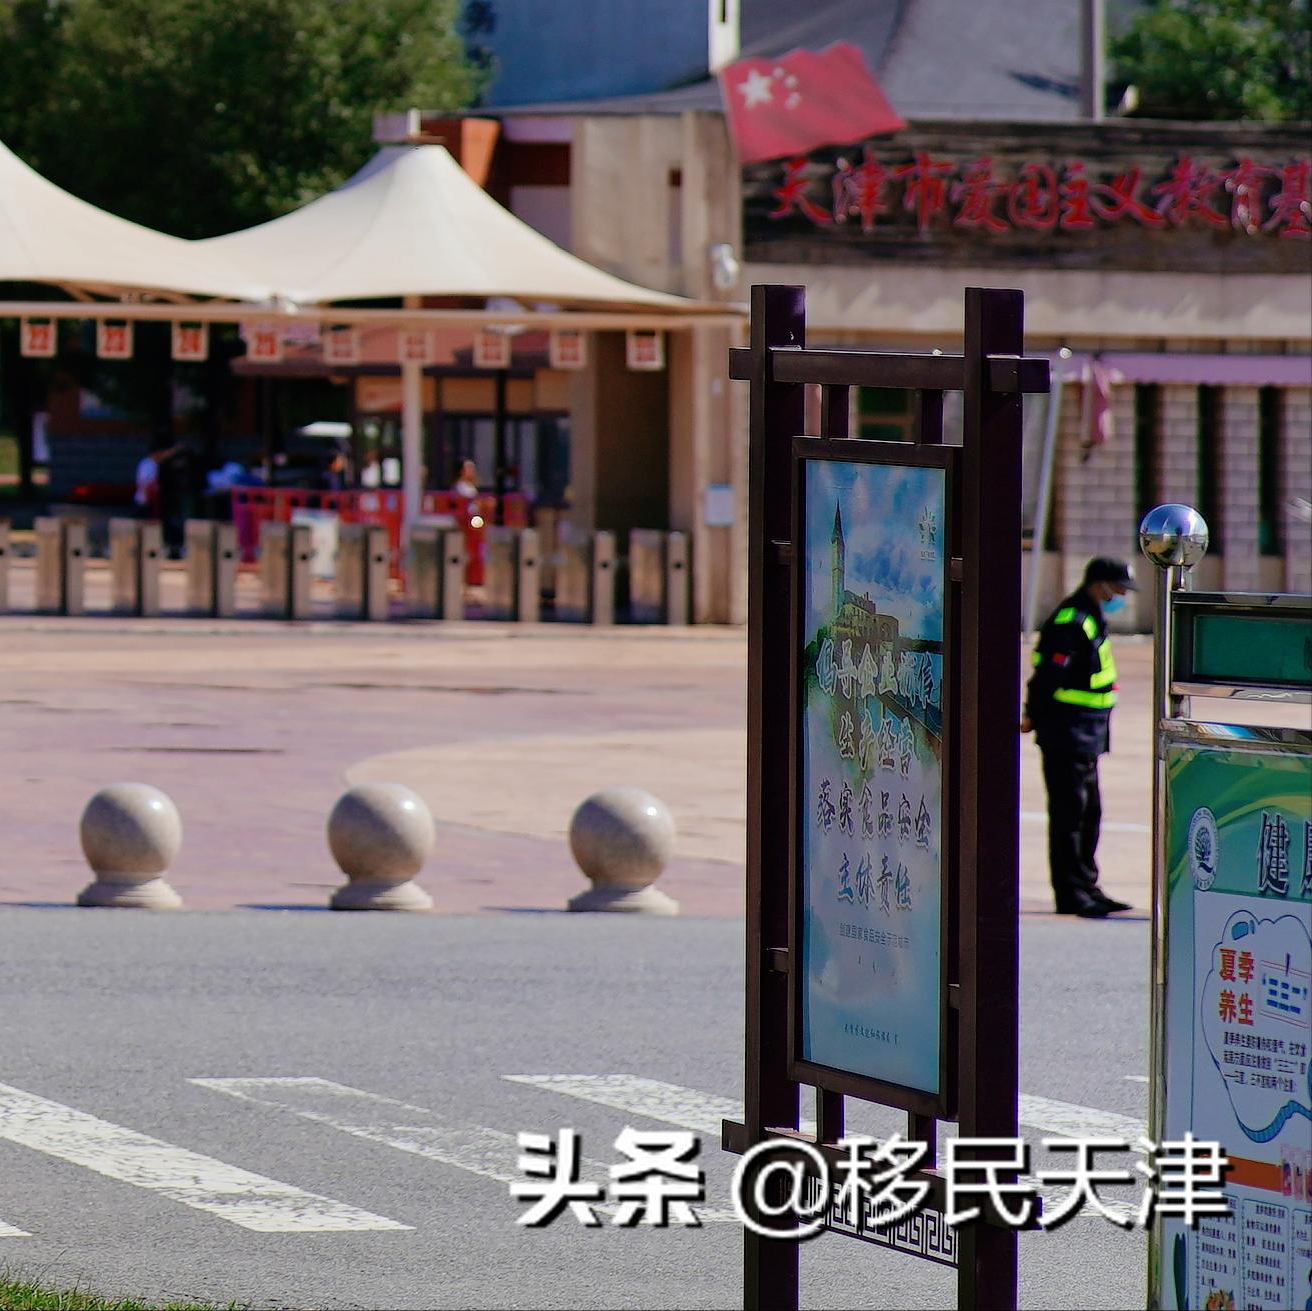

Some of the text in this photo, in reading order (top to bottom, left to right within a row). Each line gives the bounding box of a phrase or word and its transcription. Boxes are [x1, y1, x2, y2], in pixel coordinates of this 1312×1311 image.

[838, 708, 915, 779] 生产经营
[816, 777, 932, 850] 落实食品安全
[837, 851, 913, 916] 主体责任
[1219, 948, 1255, 985] 夏季
[1219, 988, 1255, 1026] 养生
